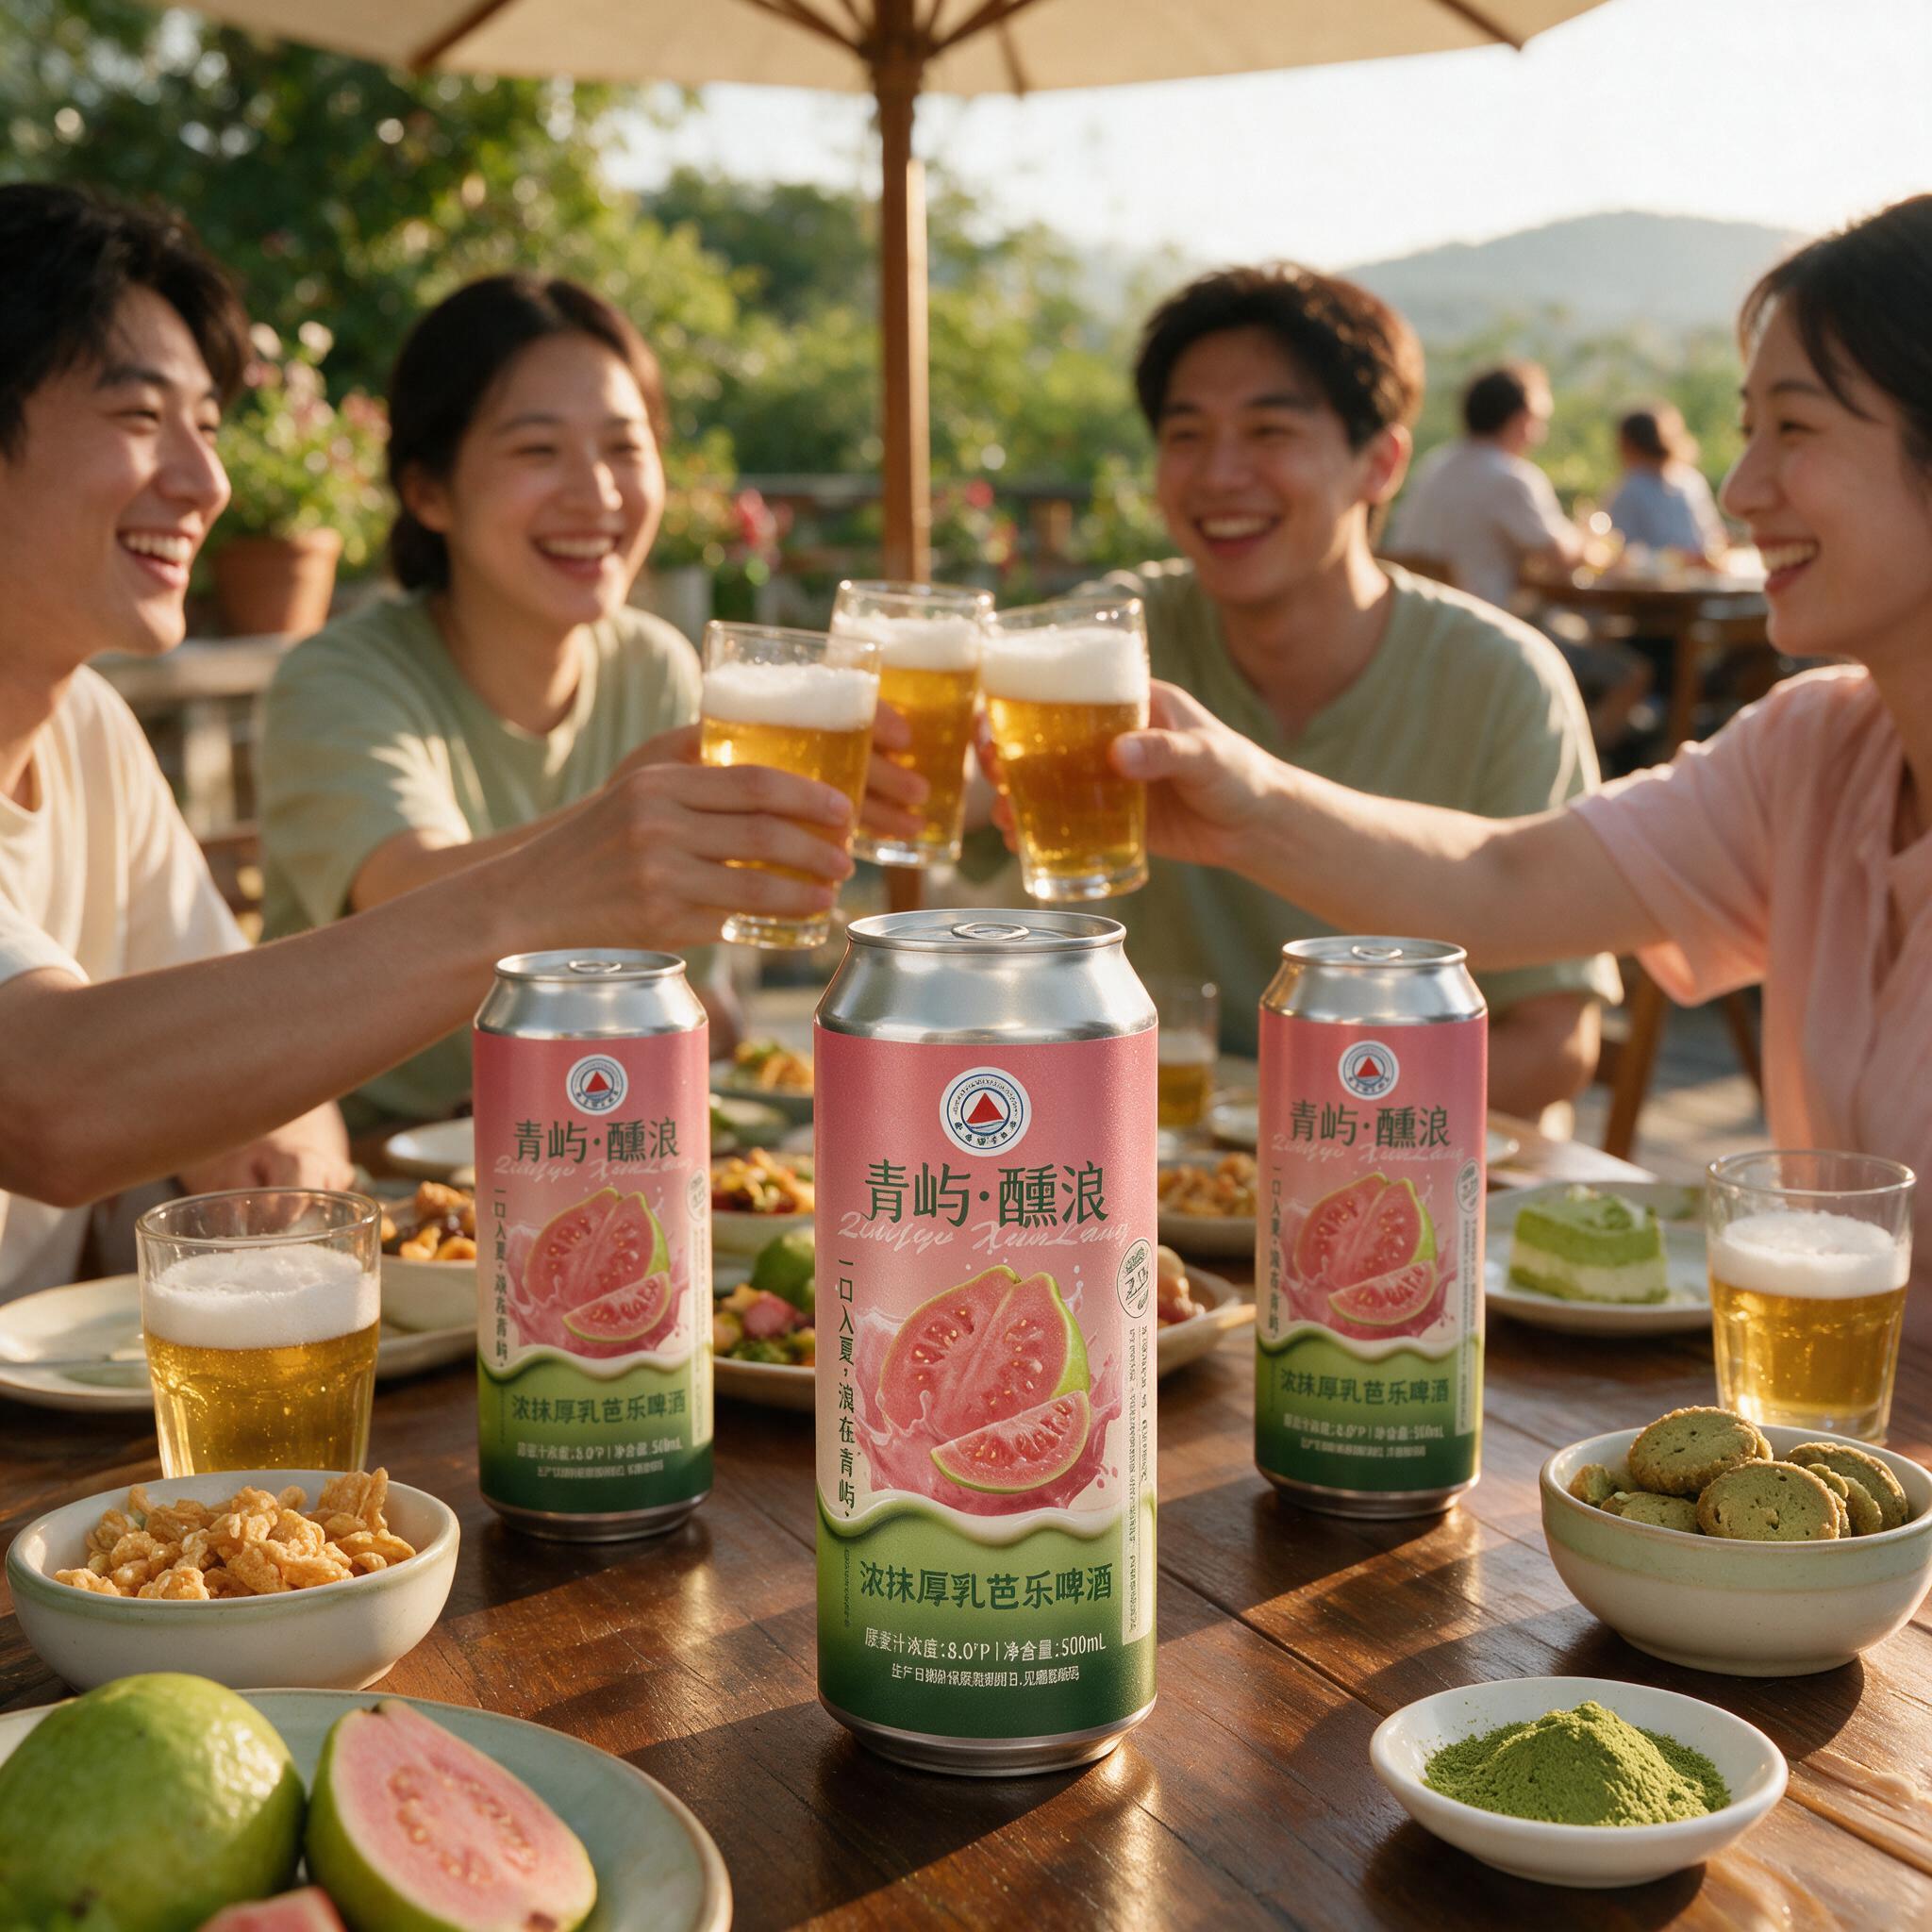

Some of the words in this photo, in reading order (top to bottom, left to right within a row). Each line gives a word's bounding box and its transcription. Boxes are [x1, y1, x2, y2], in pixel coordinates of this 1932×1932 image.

[864, 1158, 1108, 1228] 青屿·醺浪
[859, 1559, 1113, 1610] 浓抹厚乳芭乐啤酒
